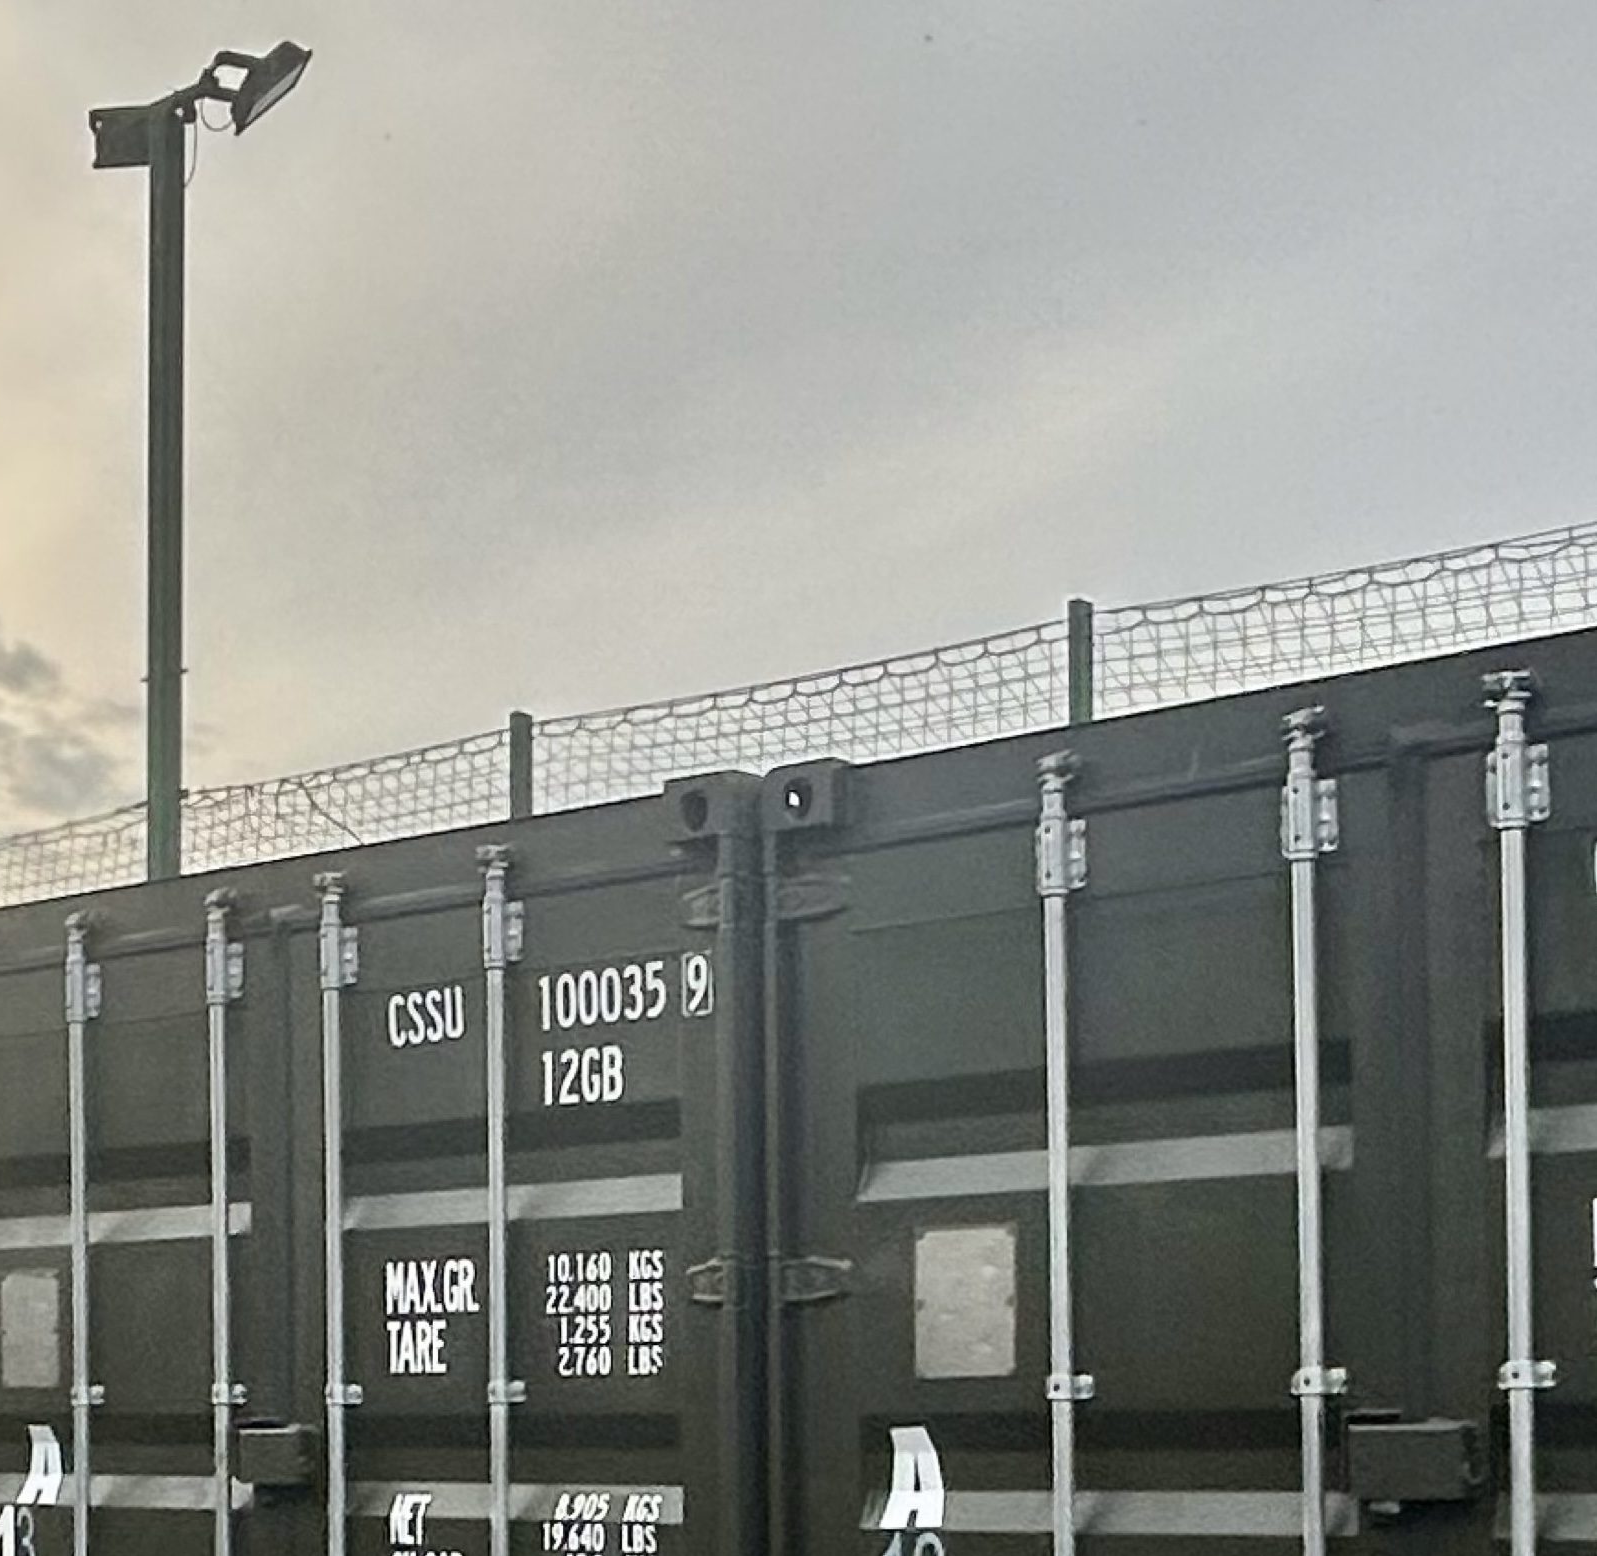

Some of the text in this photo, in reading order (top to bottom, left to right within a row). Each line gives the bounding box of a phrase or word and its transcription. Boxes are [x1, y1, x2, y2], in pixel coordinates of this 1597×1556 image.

[388, 954, 710, 1047] CSSU 100035 9
[542, 1045, 624, 1105] 12GB
[547, 1249, 664, 1283] 10.160 KGS
[628, 1281, 664, 1312] LBS
[386, 1319, 447, 1374] TARE
[560, 1313, 664, 1345] 1.255 KGS
[628, 1345, 664, 1375] LBS
[16, 1424, 64, 1505] A
[879, 1426, 945, 1529] A
[389, 1493, 432, 1545] NET
[621, 1523, 657, 1554] LBS
